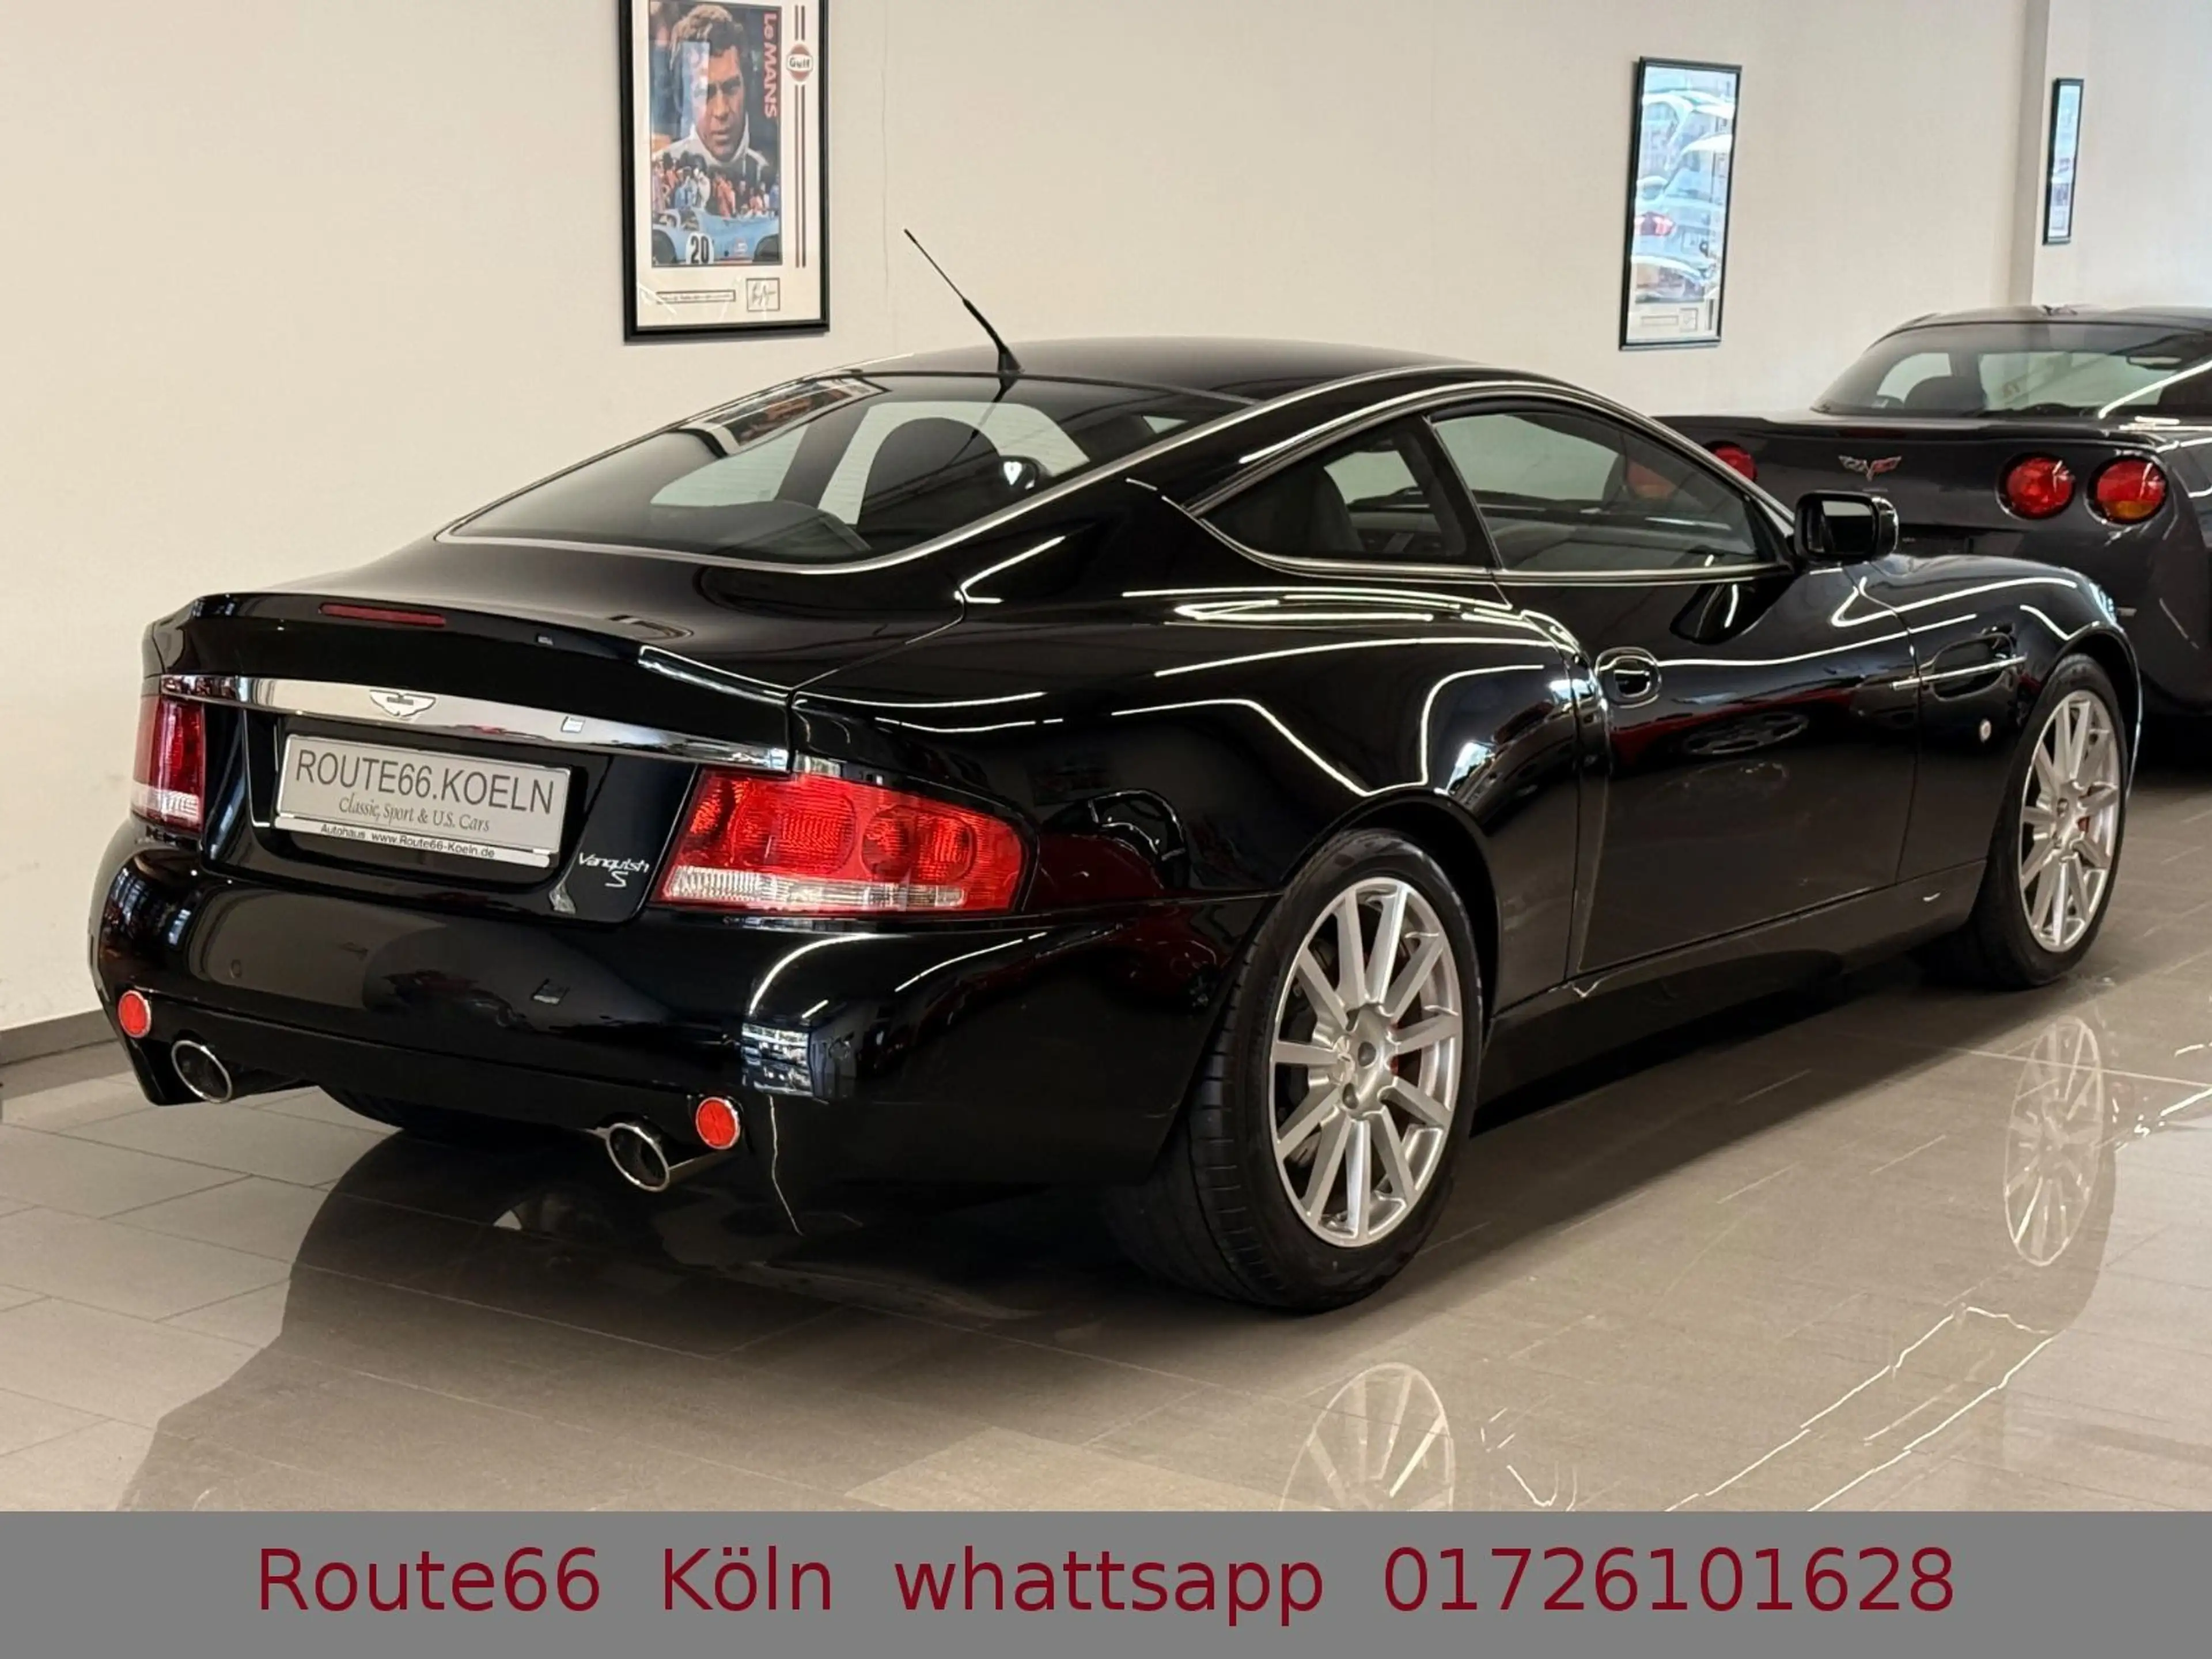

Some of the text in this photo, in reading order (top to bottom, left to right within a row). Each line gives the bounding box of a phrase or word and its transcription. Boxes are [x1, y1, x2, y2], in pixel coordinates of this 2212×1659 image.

[789, 57, 810, 69] Gulf
[764, 42, 777, 118] MANS
[690, 235, 709, 264] 20
[296, 749, 554, 814] ROUTE66.KOELN
[339, 793, 490, 832] Classic, Sport & U.S. Cars
[320, 823, 495, 858] Autohaus www.Route66-Koeln.de
[578, 851, 650, 873] Vanquish
[604, 870, 628, 888] S
